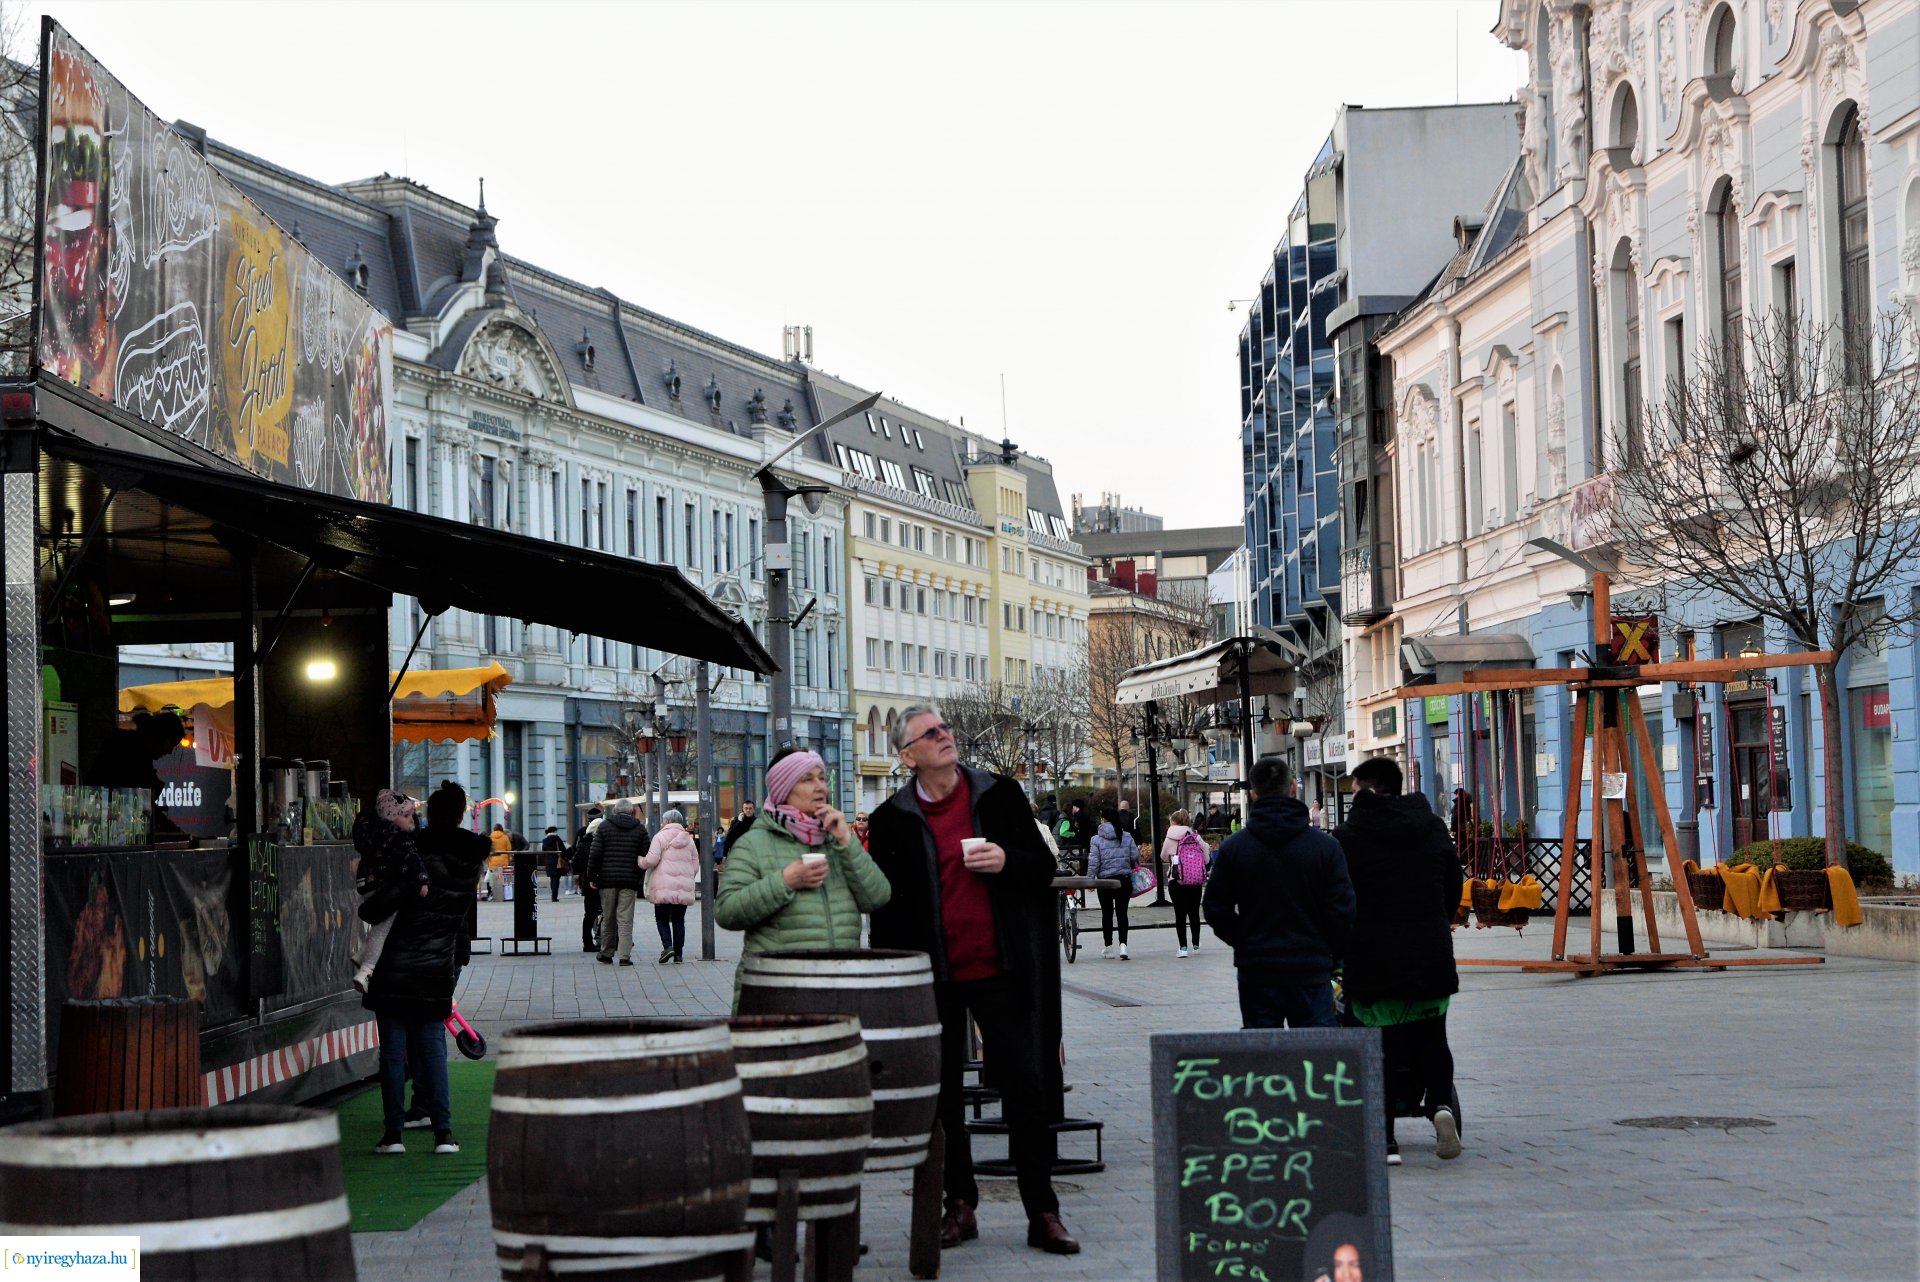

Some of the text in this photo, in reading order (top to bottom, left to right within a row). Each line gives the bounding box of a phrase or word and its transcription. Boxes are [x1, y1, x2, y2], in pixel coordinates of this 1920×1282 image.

[230, 247, 278, 347] Street
[239, 313, 288, 449] Food
[258, 423, 286, 457] PALACE
[1171, 1058, 1364, 1107] Forralt
[1223, 1106, 1324, 1145] Bor
[1181, 1150, 1315, 1191] EPER
[1205, 1191, 1312, 1236] BOR
